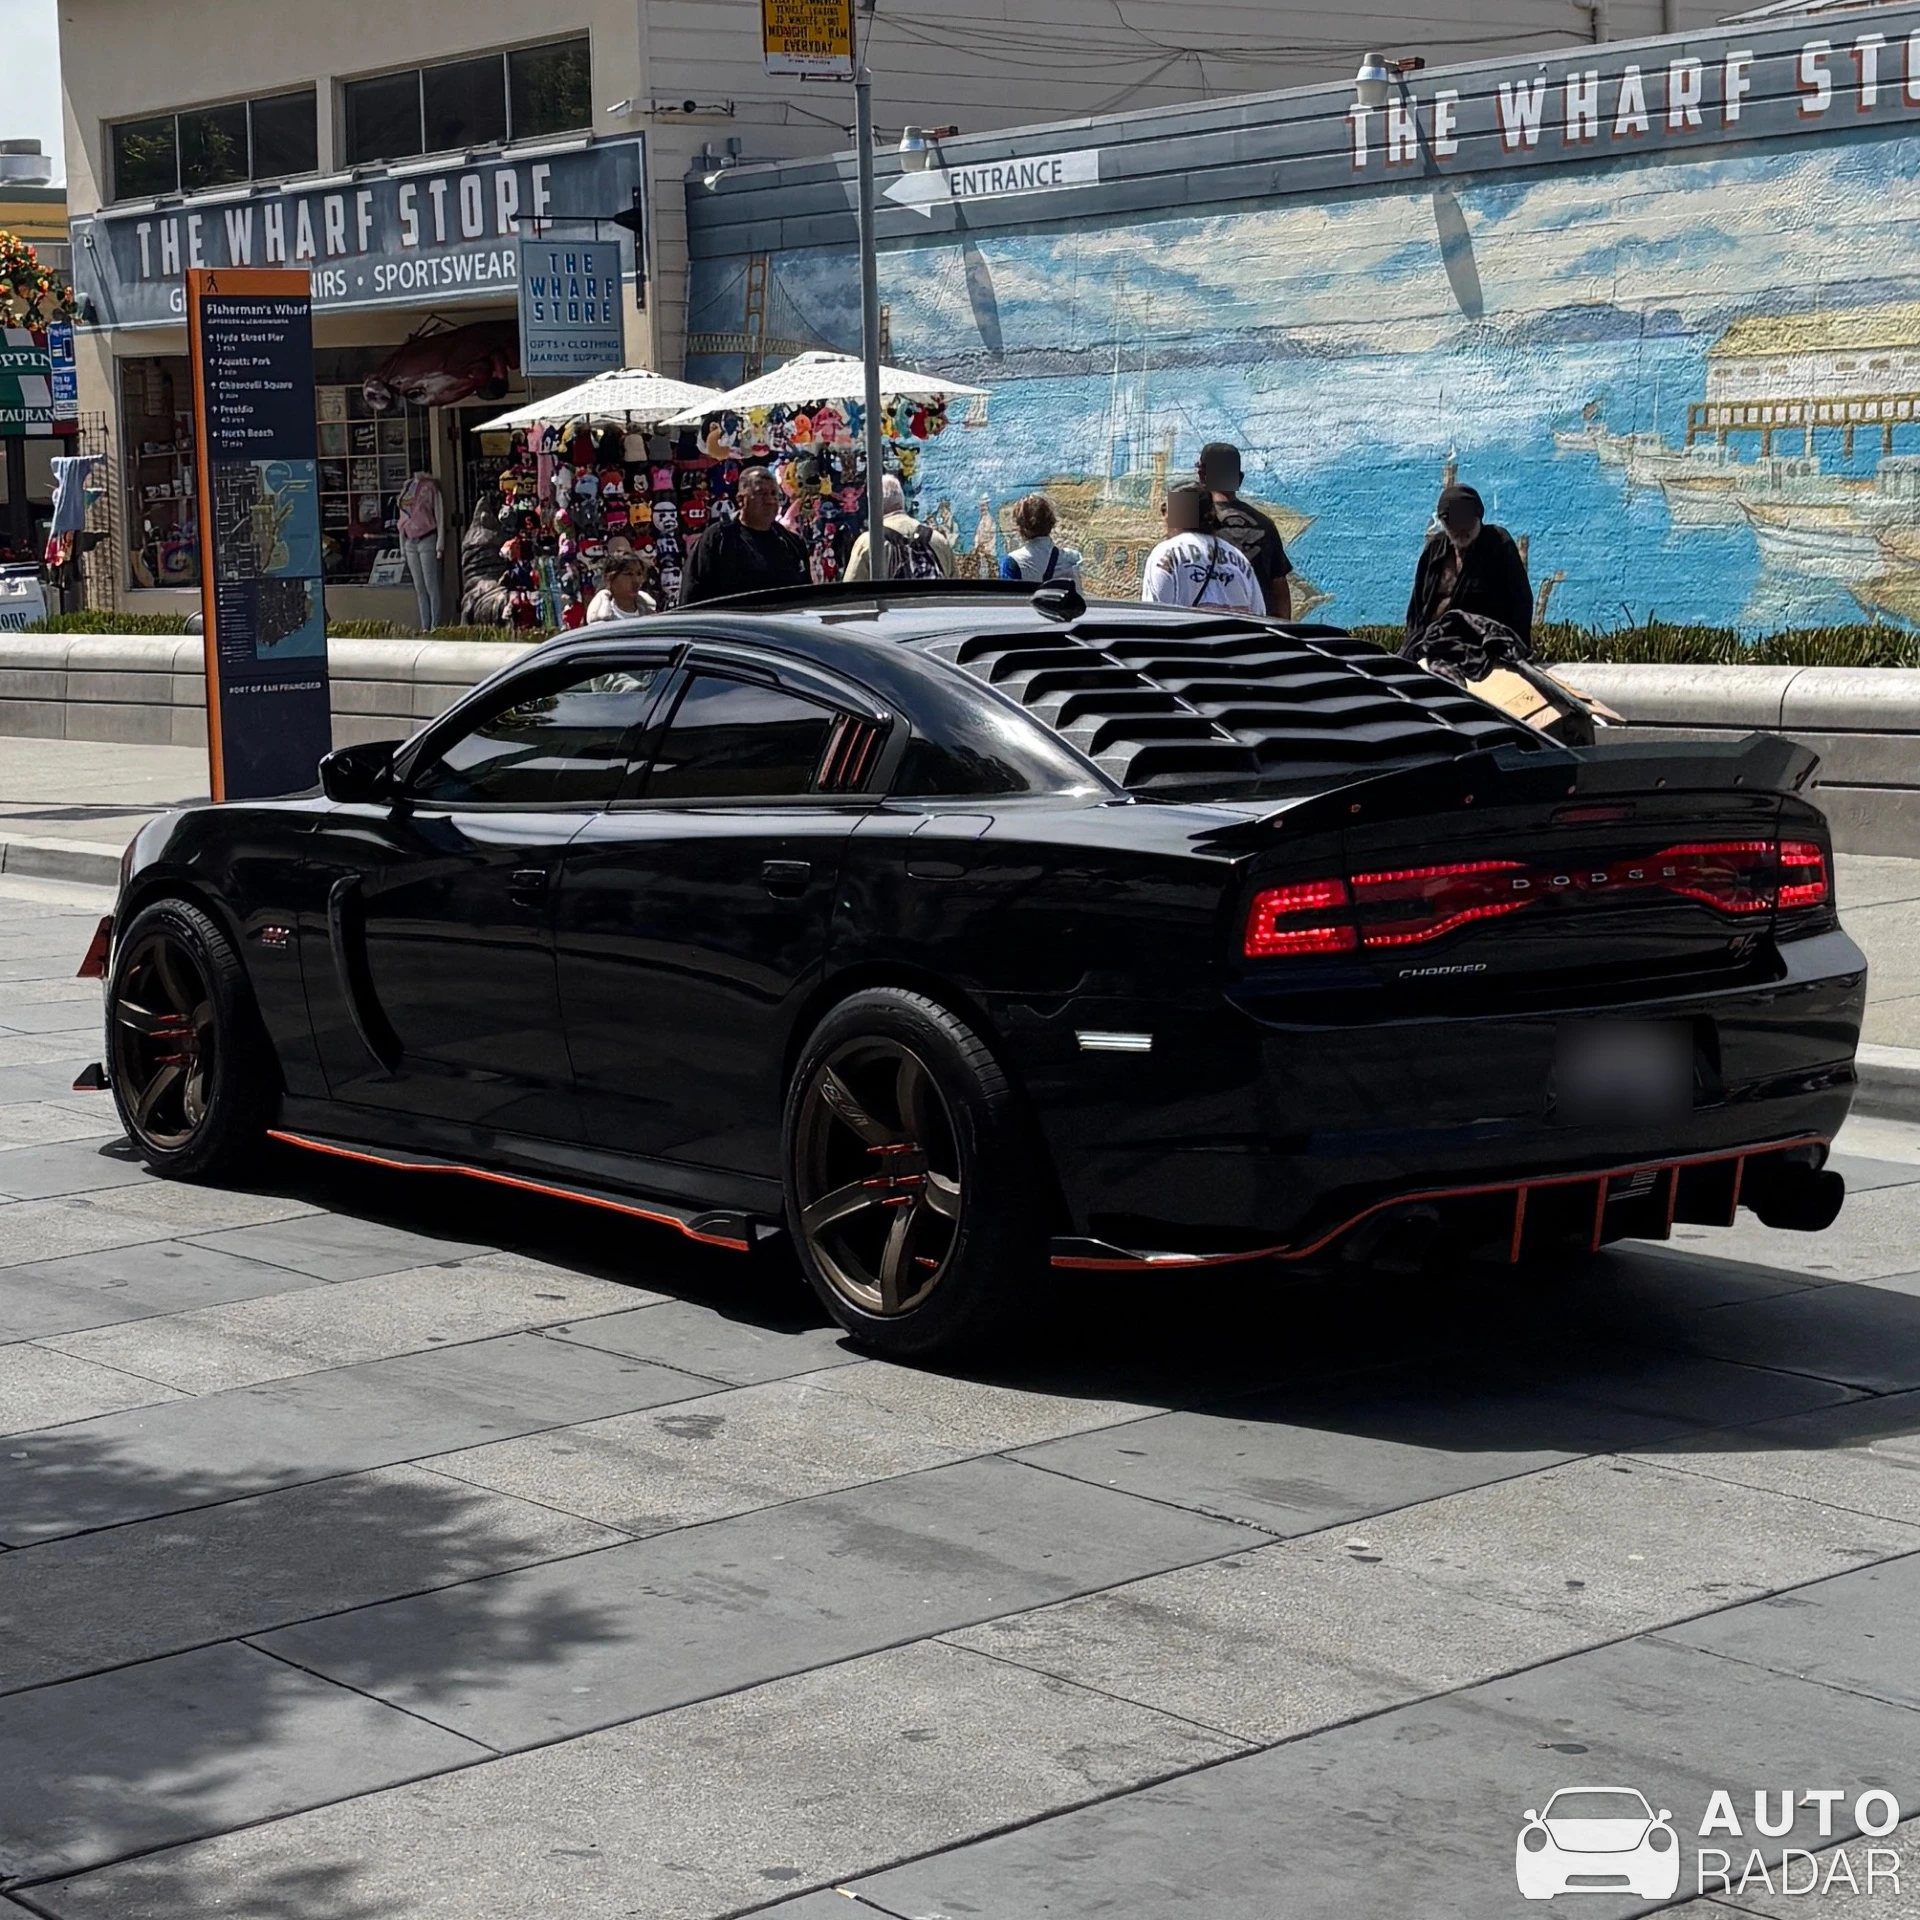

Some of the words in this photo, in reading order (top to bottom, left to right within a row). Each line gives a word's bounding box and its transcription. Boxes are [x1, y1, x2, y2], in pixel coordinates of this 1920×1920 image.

[784, 40, 833, 53] EVERYDAY
[1350, 89, 1459, 167] THE
[1496, 50, 1753, 150] WHARF
[951, 159, 1062, 196] ENTRANCE
[136, 214, 205, 278] THE
[225, 190, 373, 267] WHARF
[400, 163, 553, 247] STORE
[374, 250, 516, 292] SPORTSWEAR
[549, 253, 593, 275] THE
[529, 276, 614, 299] WHARF
[207, 304, 272, 315] Fisherman's
[274, 304, 308, 315] Wharf
[534, 302, 612, 324] STORE
[216, 333, 239, 343] Hyde
[241, 334, 266, 342] Street
[264, 381, 293, 390] Square
[221, 429, 246, 438] North
[247, 428, 274, 437] Beach
[1513, 866, 1677, 889] DODGE
